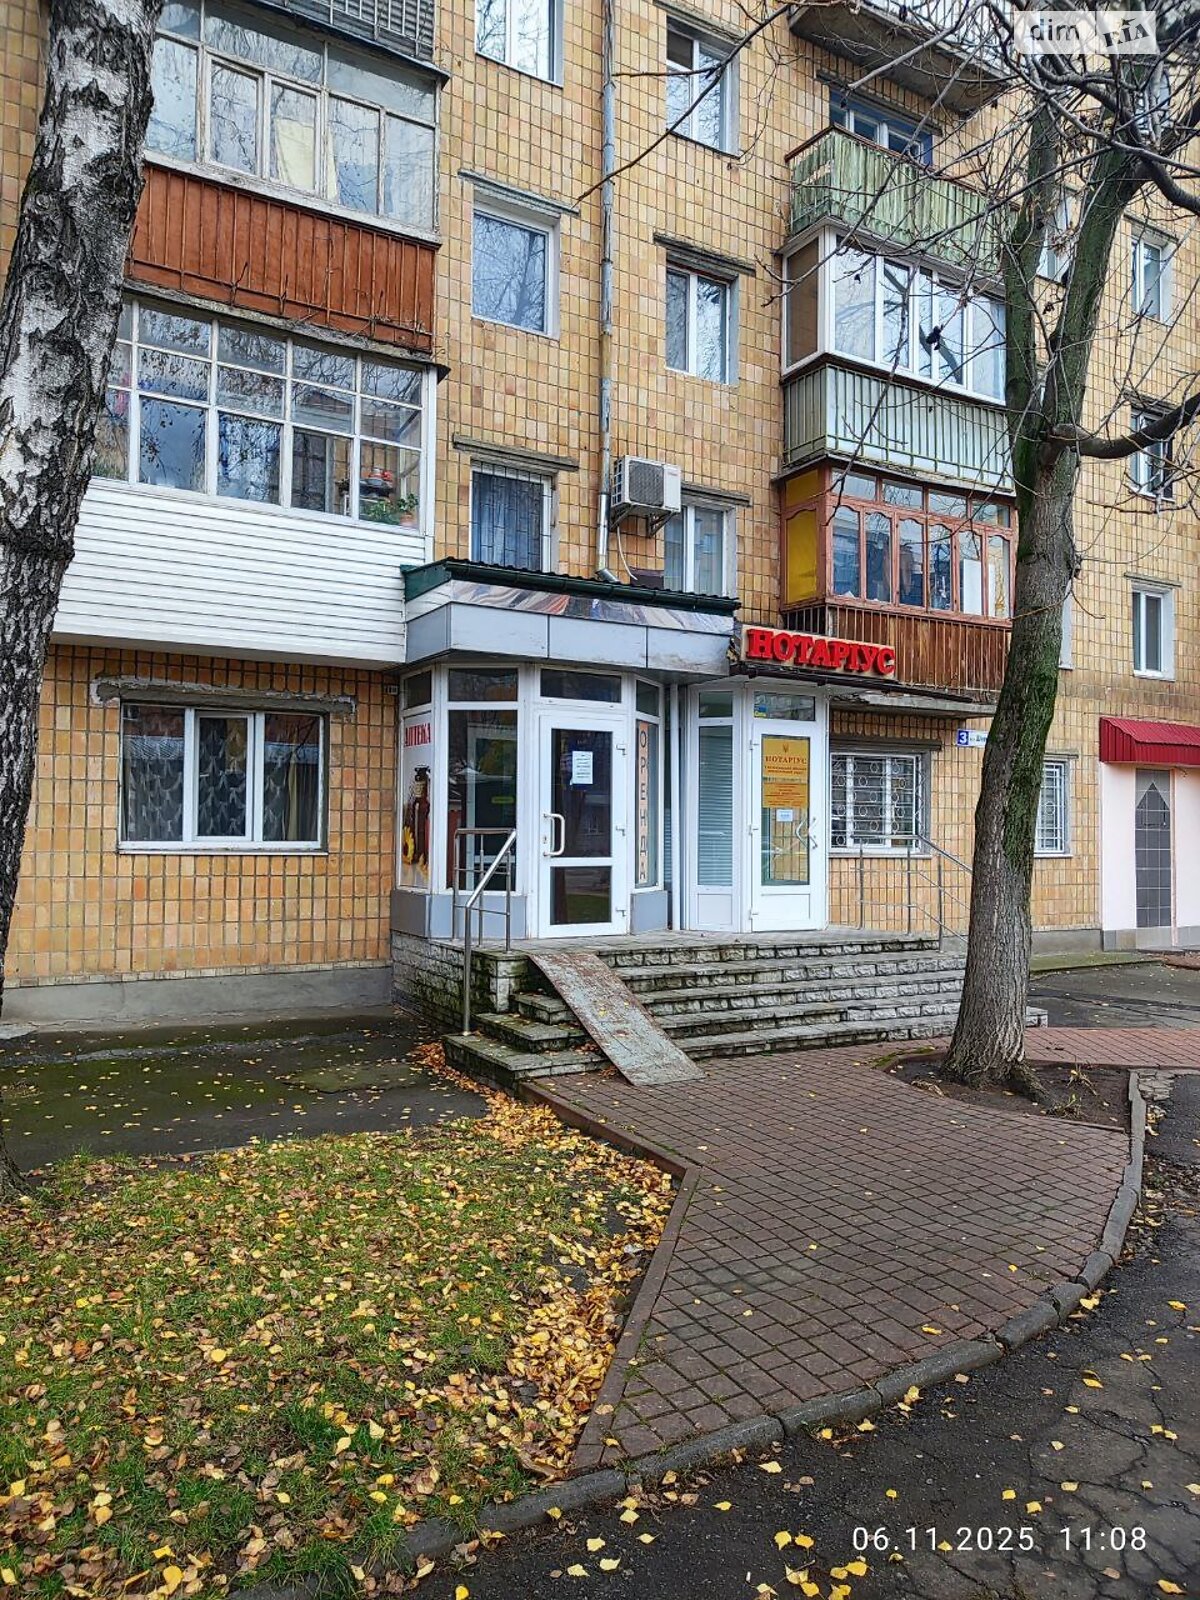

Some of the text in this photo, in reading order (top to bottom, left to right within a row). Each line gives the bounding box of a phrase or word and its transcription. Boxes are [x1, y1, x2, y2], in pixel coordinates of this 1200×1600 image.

[747, 628, 896, 675] НОТАРІУС
[404, 722, 431, 747] АПТЕКА
[959, 732, 967, 744] 3
[765, 755, 807, 765] НОТАРІУС
[639, 730, 647, 880] ОРЕНДА
